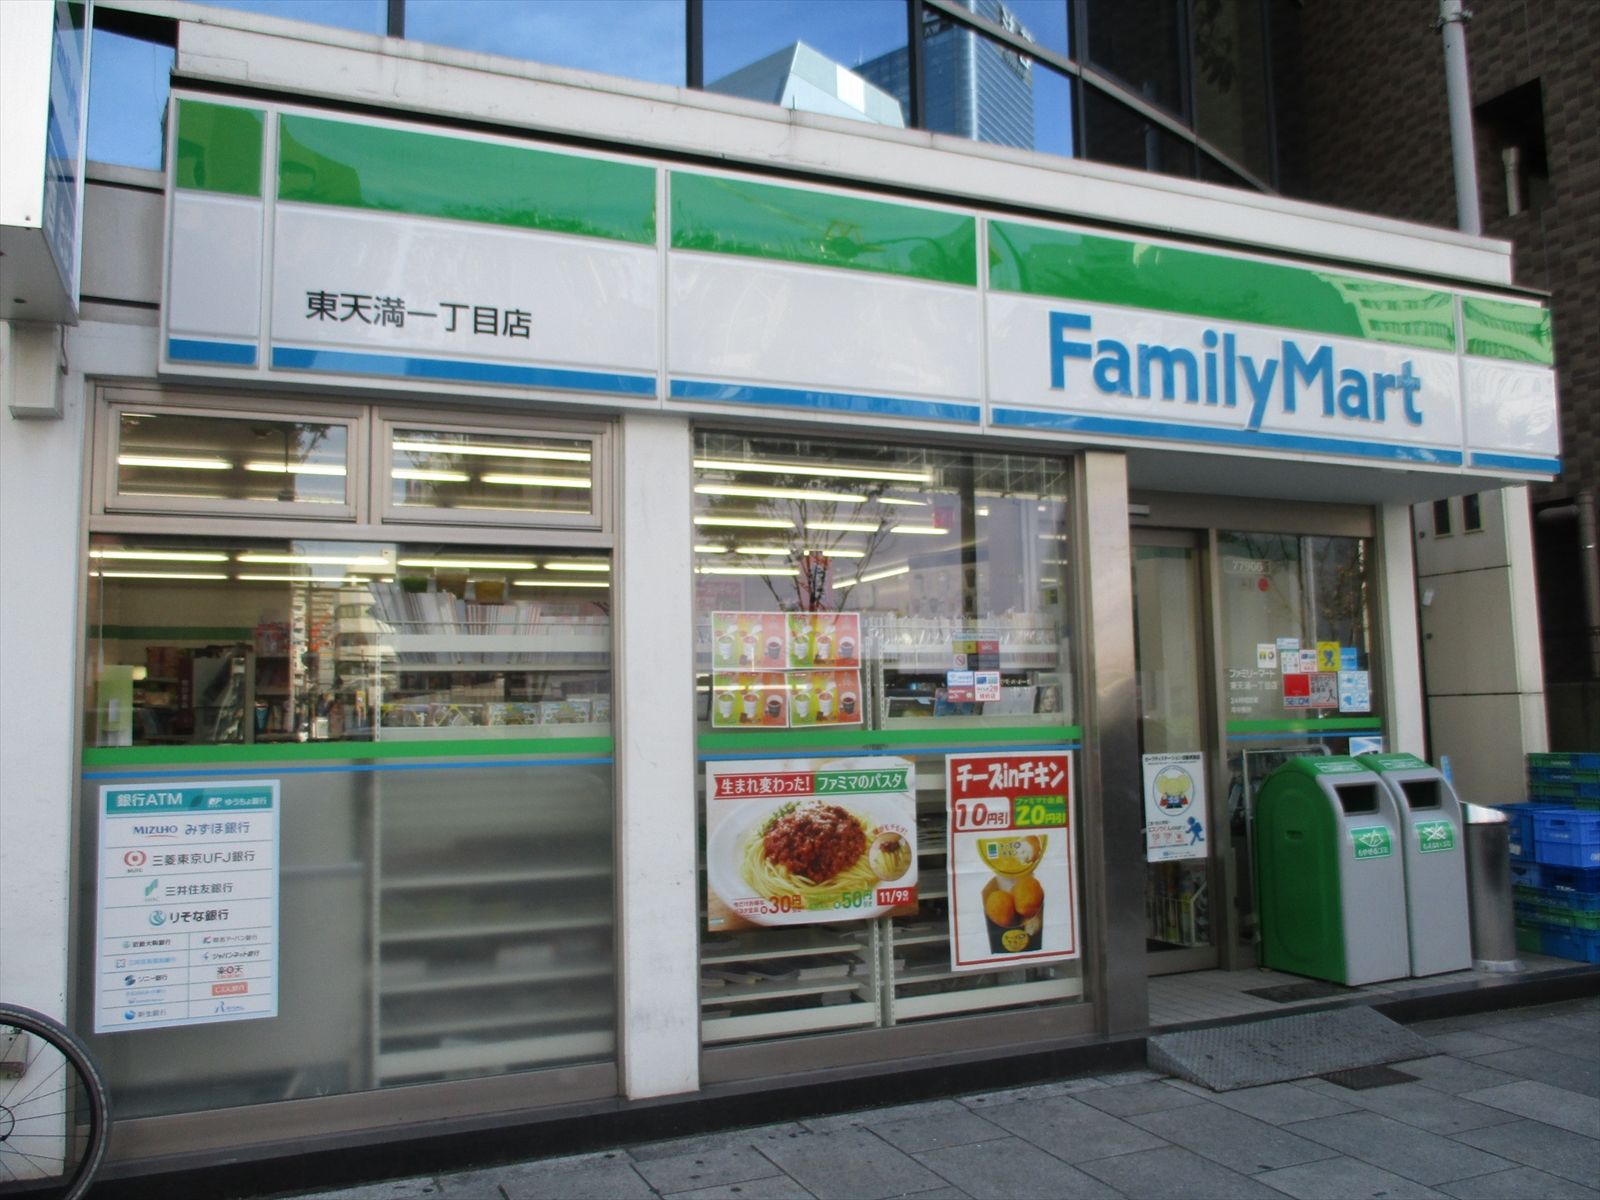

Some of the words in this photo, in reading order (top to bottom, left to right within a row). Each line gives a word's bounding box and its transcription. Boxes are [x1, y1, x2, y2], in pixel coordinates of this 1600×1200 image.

[305, 290, 532, 339] 東天満一丁目店
[1048, 310, 1424, 432] FamilyMart
[721, 776, 810, 795] 生まれ変わった!
[818, 773, 902, 791] ファミマのパスタ
[956, 761, 1065, 792] チーズinチキン
[116, 792, 183, 807] 銀行ATM
[957, 802, 1009, 826] 10円引
[1015, 804, 1066, 826] 20円引
[133, 825, 178, 835] MIZUHO
[184, 821, 250, 835] みずほ銀行
[152, 851, 256, 867] 三菱東京UFJ銀行
[164, 882, 234, 897] 三井住友銀行
[169, 908, 229, 924] りそな銀行
